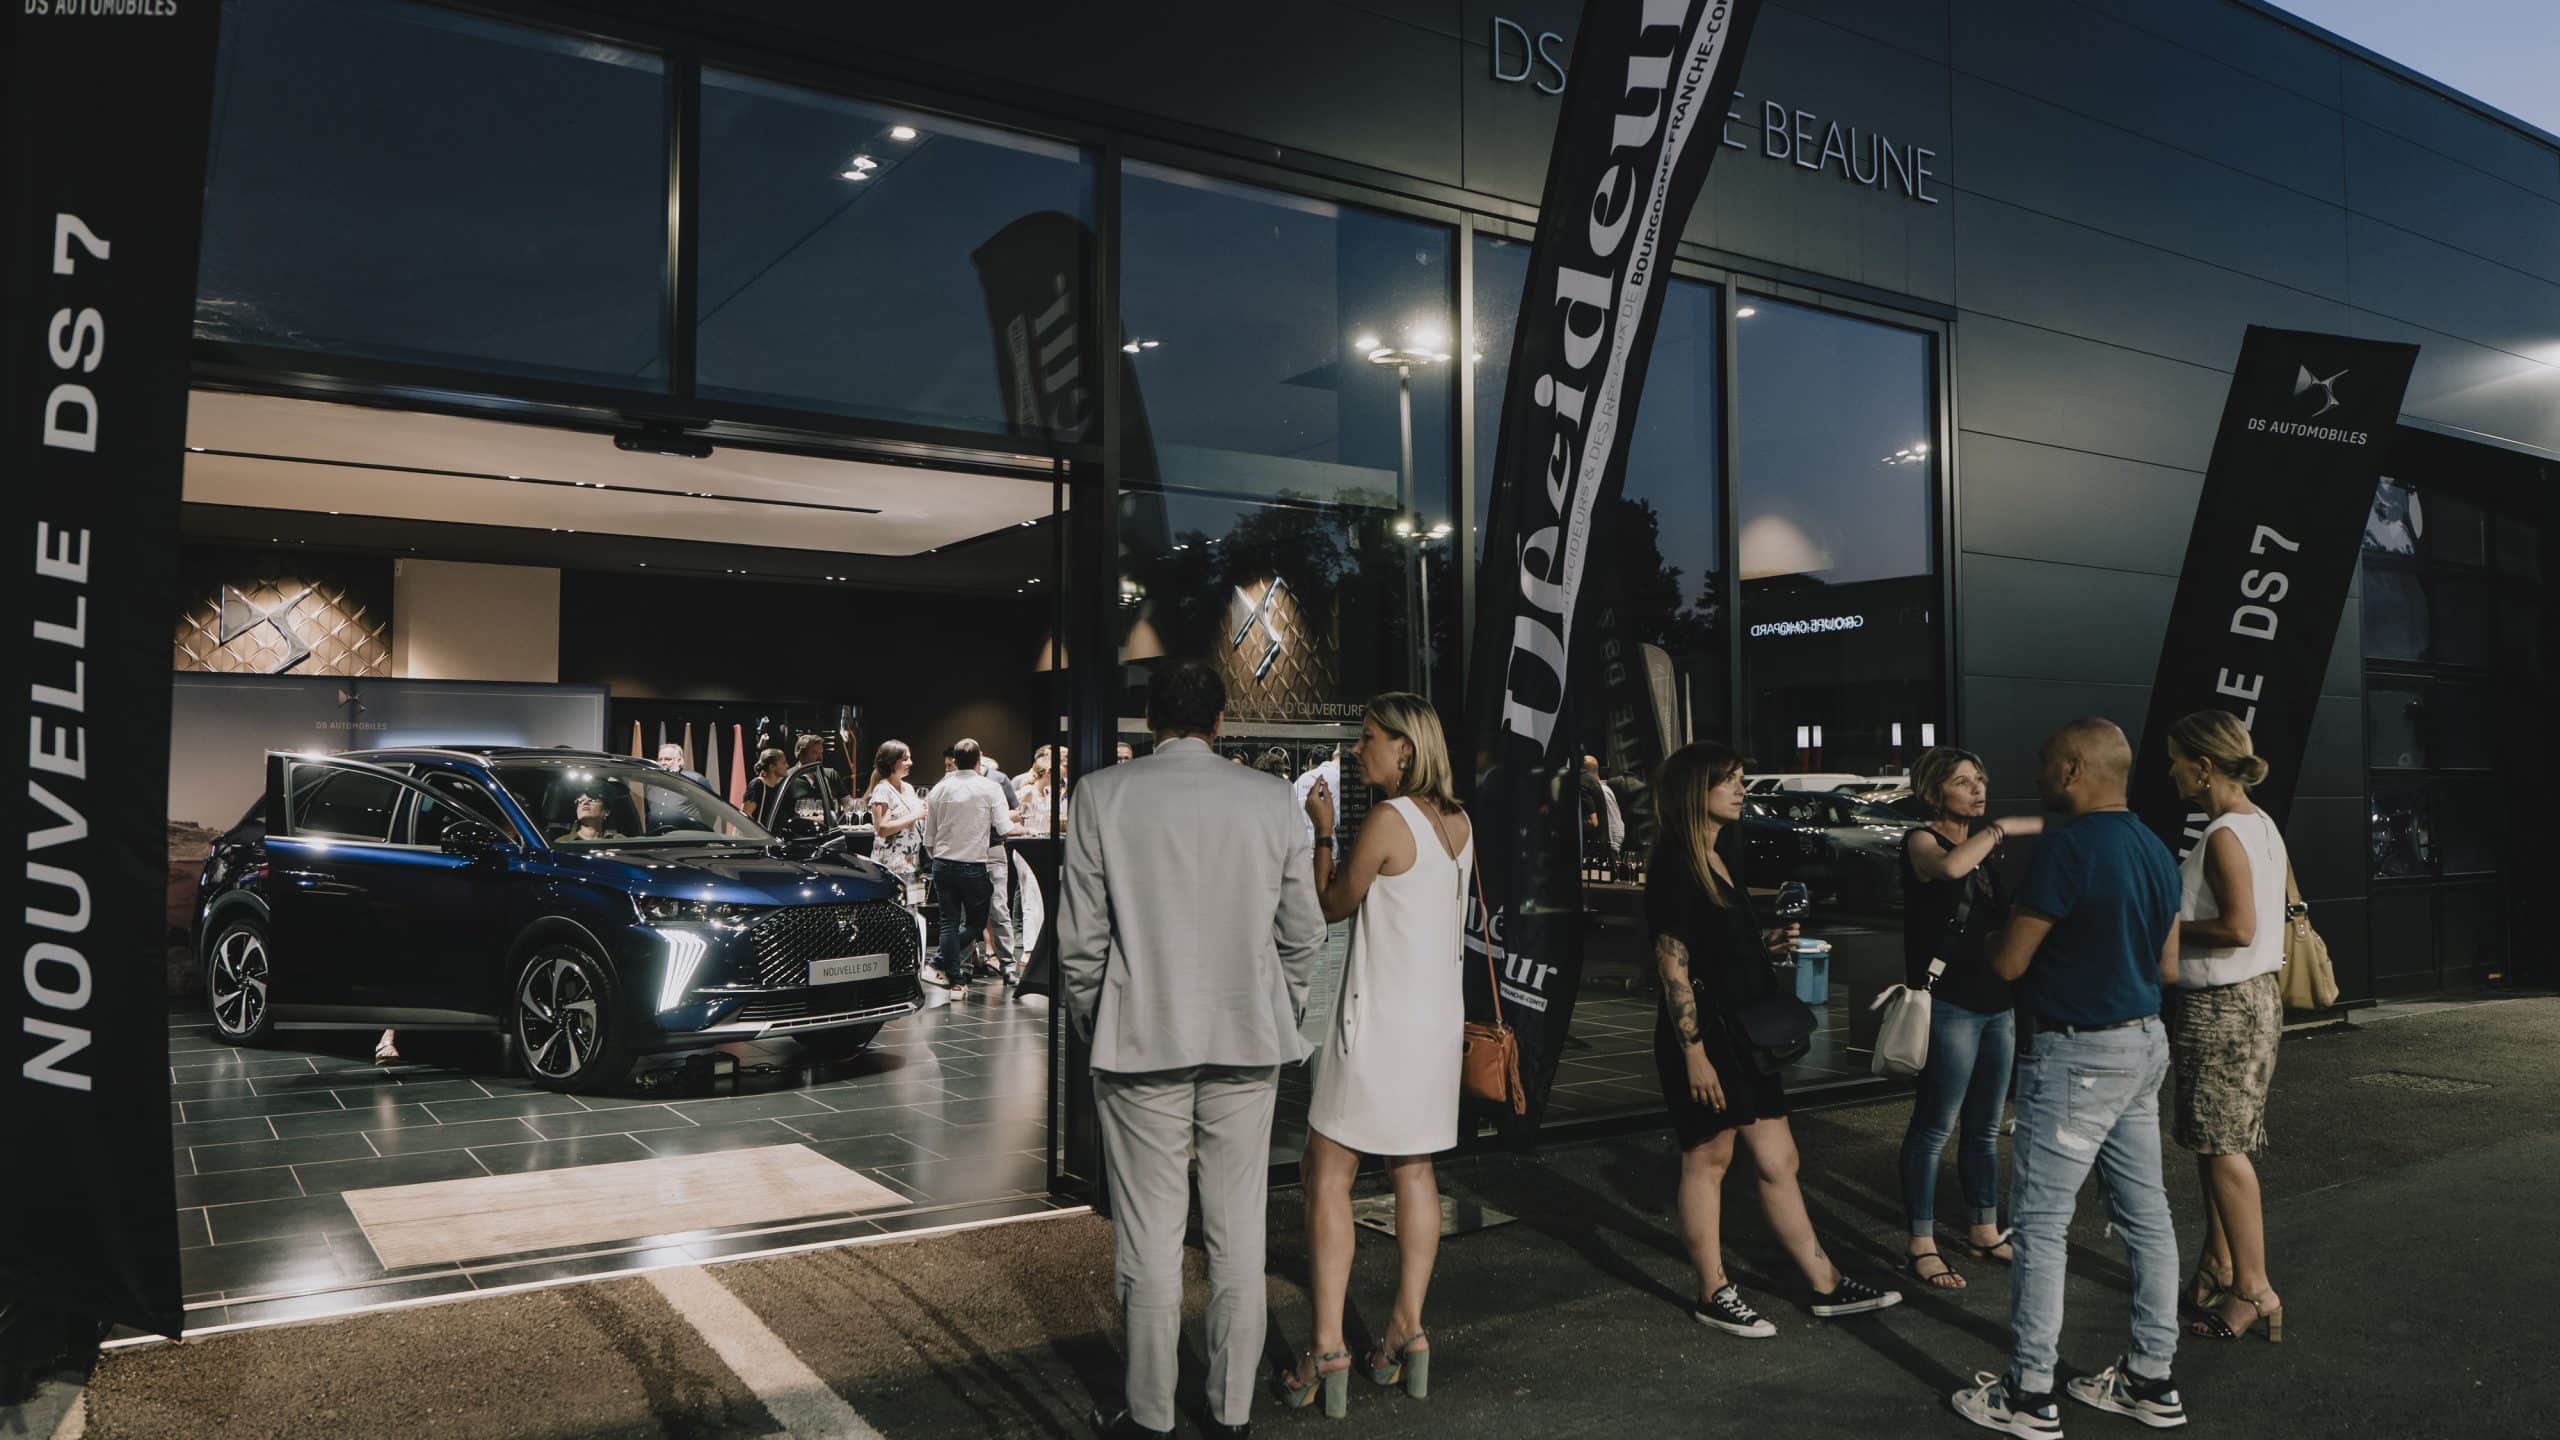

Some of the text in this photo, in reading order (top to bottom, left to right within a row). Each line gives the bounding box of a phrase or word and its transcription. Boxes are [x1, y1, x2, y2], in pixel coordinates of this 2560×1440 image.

[54, 0, 178, 16] AUTOMOBILES
[1494, 15, 1567, 95] DS
[1763, 100, 1939, 205] BEAUNE
[1621, 288, 1639, 319] DE
[1589, 421, 1610, 461] DES
[2247, 417, 2368, 446] DS AUTOMOBILES
[1584, 466, 1596, 481] &
[22, 212, 111, 1092] NOUVELLE DS 7
[823, 964, 861, 977] NOUVELLE
[862, 961, 872, 973] DS
